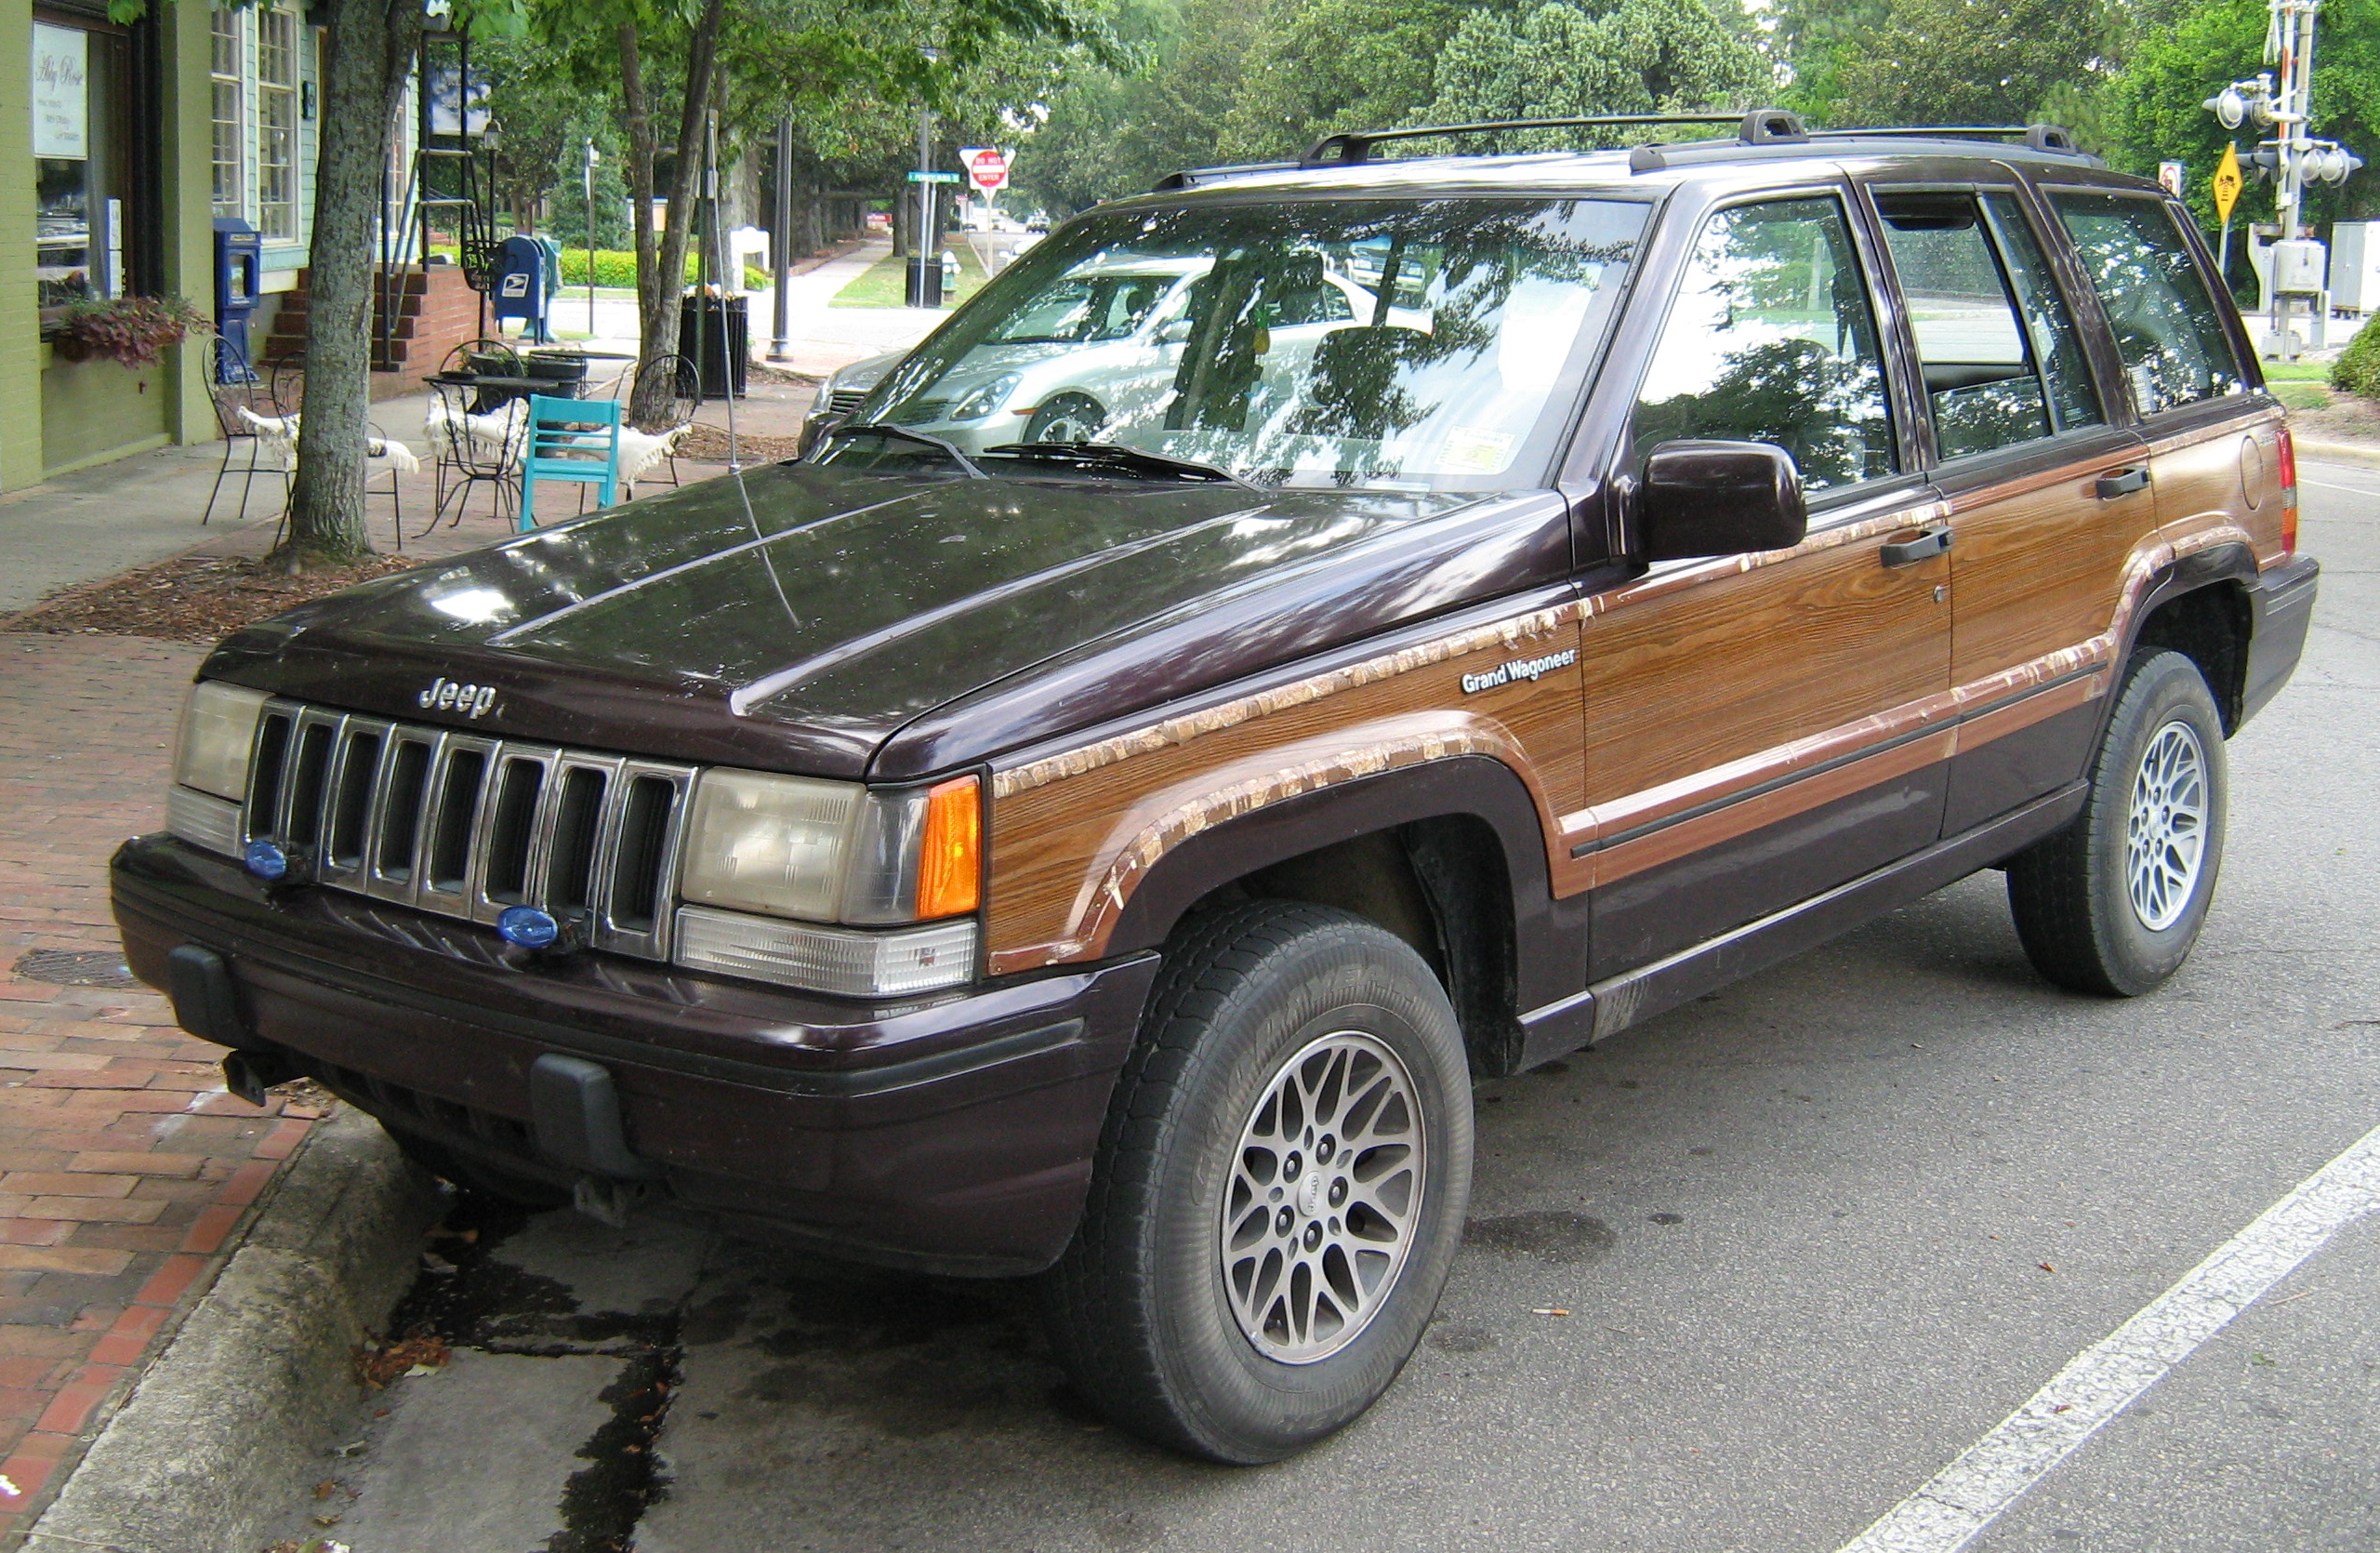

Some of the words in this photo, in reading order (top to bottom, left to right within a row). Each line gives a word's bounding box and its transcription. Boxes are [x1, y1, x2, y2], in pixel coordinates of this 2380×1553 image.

[975, 156, 985, 165] DO
[987, 155, 1001, 165] NOT
[1461, 664, 1506, 694] Grand
[1506, 648, 1576, 682] Wagoneer
[418, 677, 496, 720] Jeep
